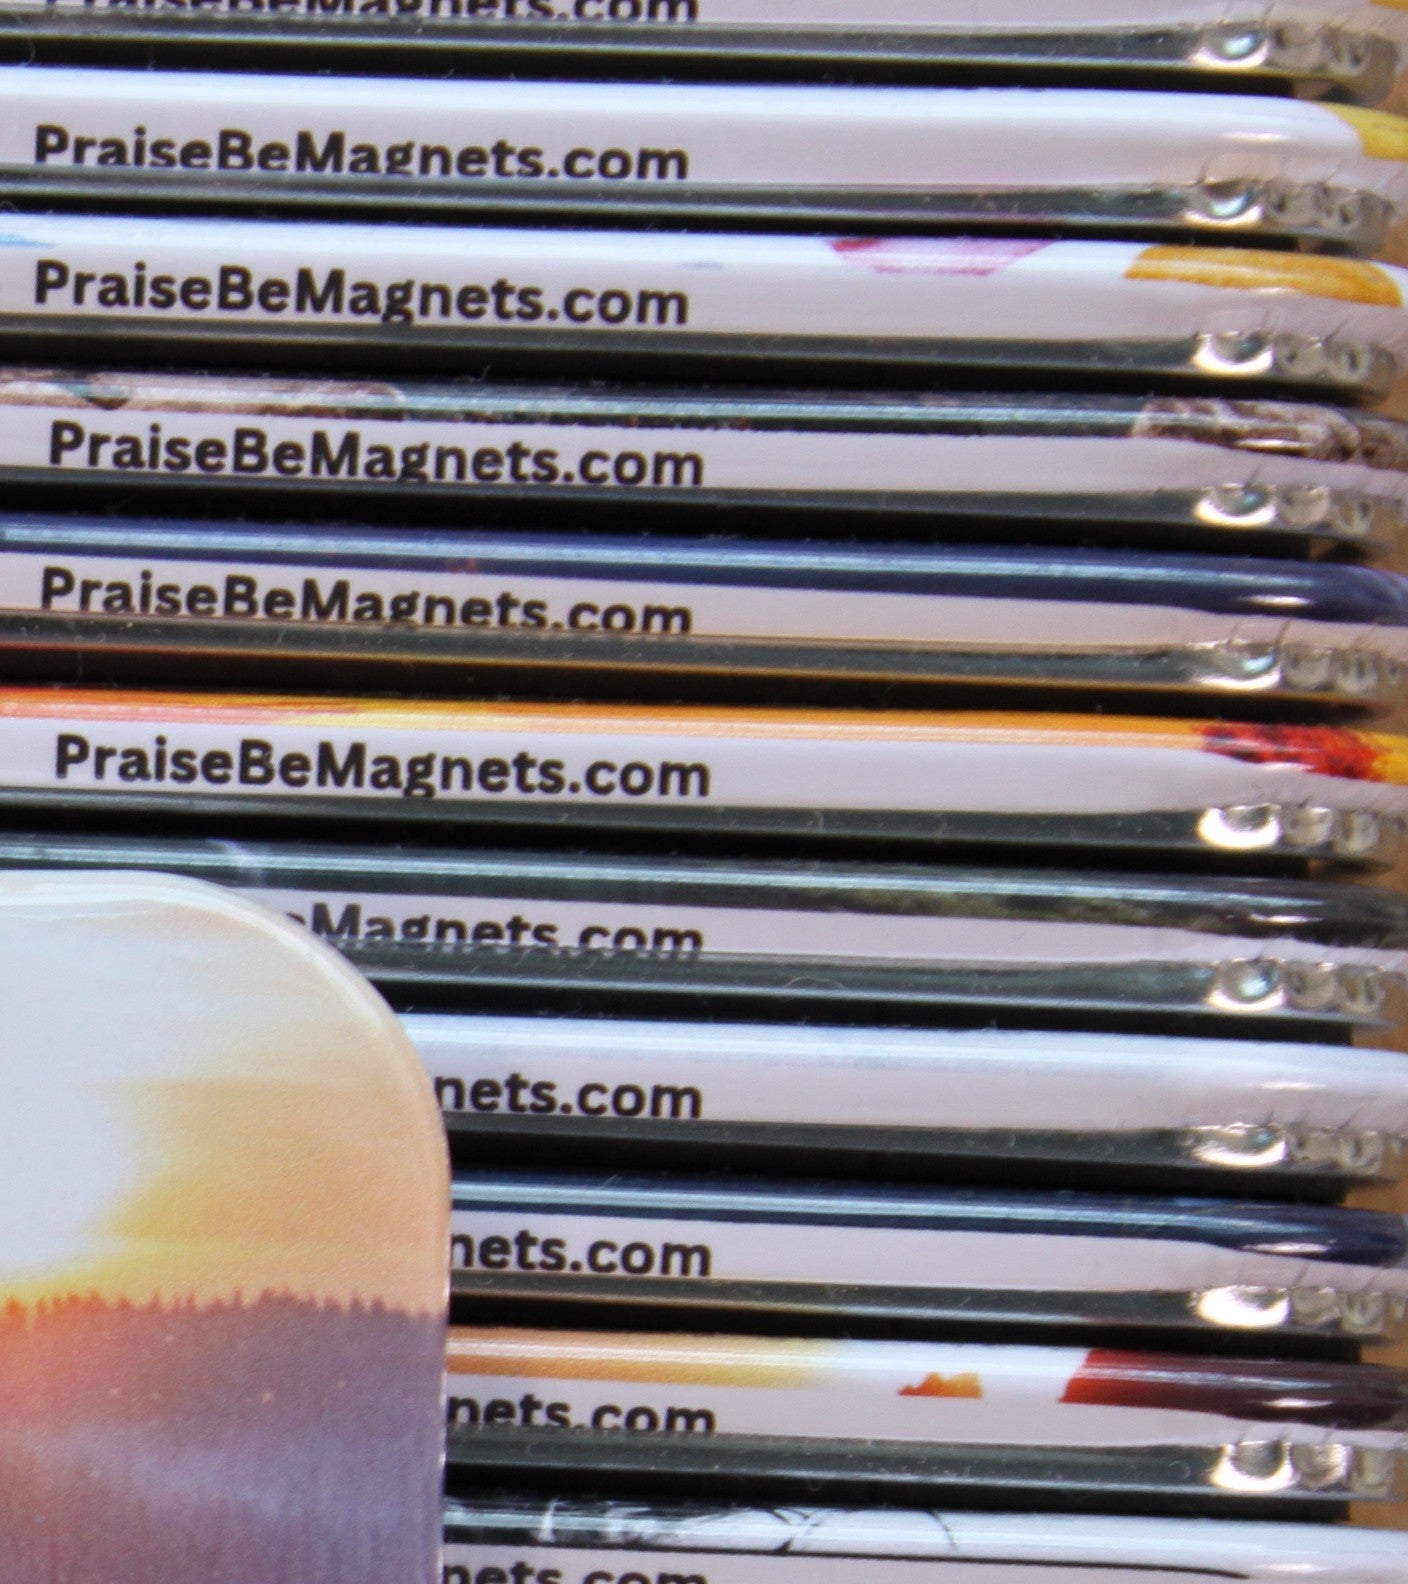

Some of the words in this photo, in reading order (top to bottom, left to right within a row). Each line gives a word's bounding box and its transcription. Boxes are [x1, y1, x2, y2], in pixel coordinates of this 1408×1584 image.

[35, 125, 689, 180] PraiseBeMagnets.com
[35, 259, 689, 325] PraiseBeMagnets.com
[49, 420, 704, 486] PraiseBeMagnets.com
[41, 566, 692, 633] PraiseBeMagnets.com
[56, 734, 711, 797] PraiseBeMagnets.com
[287, 902, 704, 952] Magnetscom
